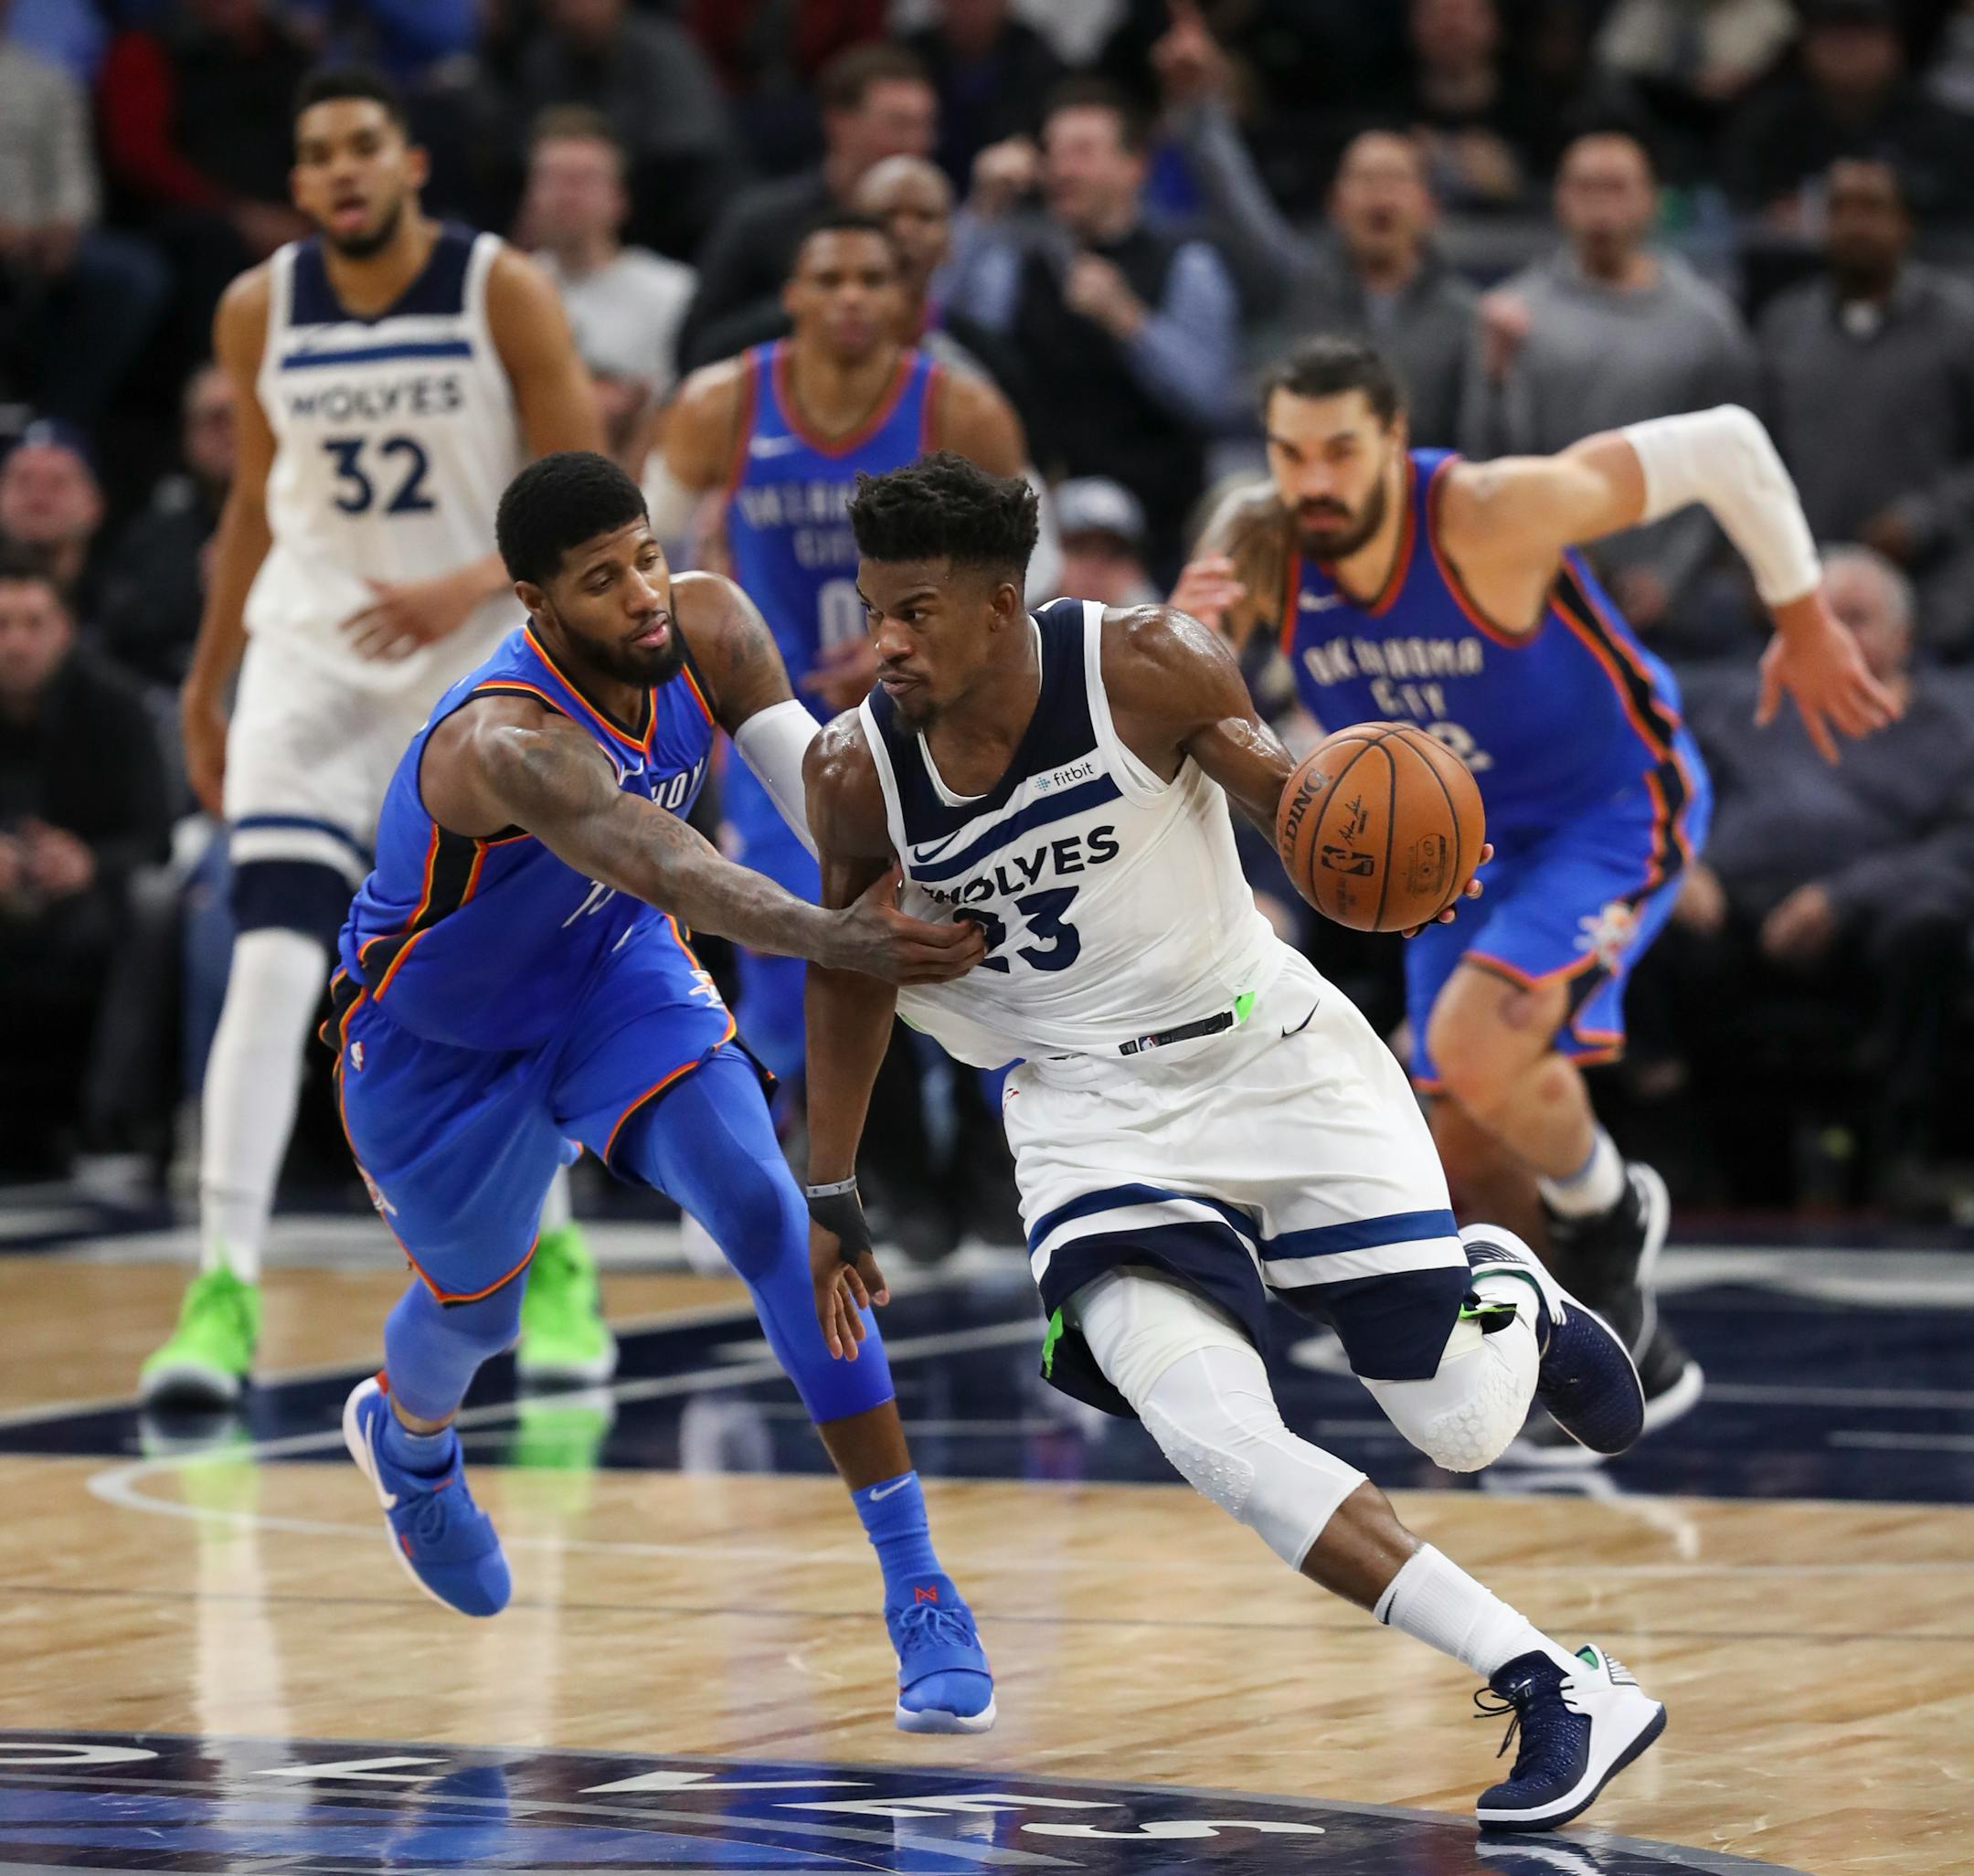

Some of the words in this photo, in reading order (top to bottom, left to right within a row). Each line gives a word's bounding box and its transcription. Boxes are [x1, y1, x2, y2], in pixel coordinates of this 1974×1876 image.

[292, 376, 462, 419] WOLVES
[324, 436, 437, 515] 32
[1303, 637, 1483, 686] OKLAHOMA
[1371, 678, 1446, 719] CITY
[1054, 762, 1094, 786] fitbit
[953, 885, 1081, 973] 23
